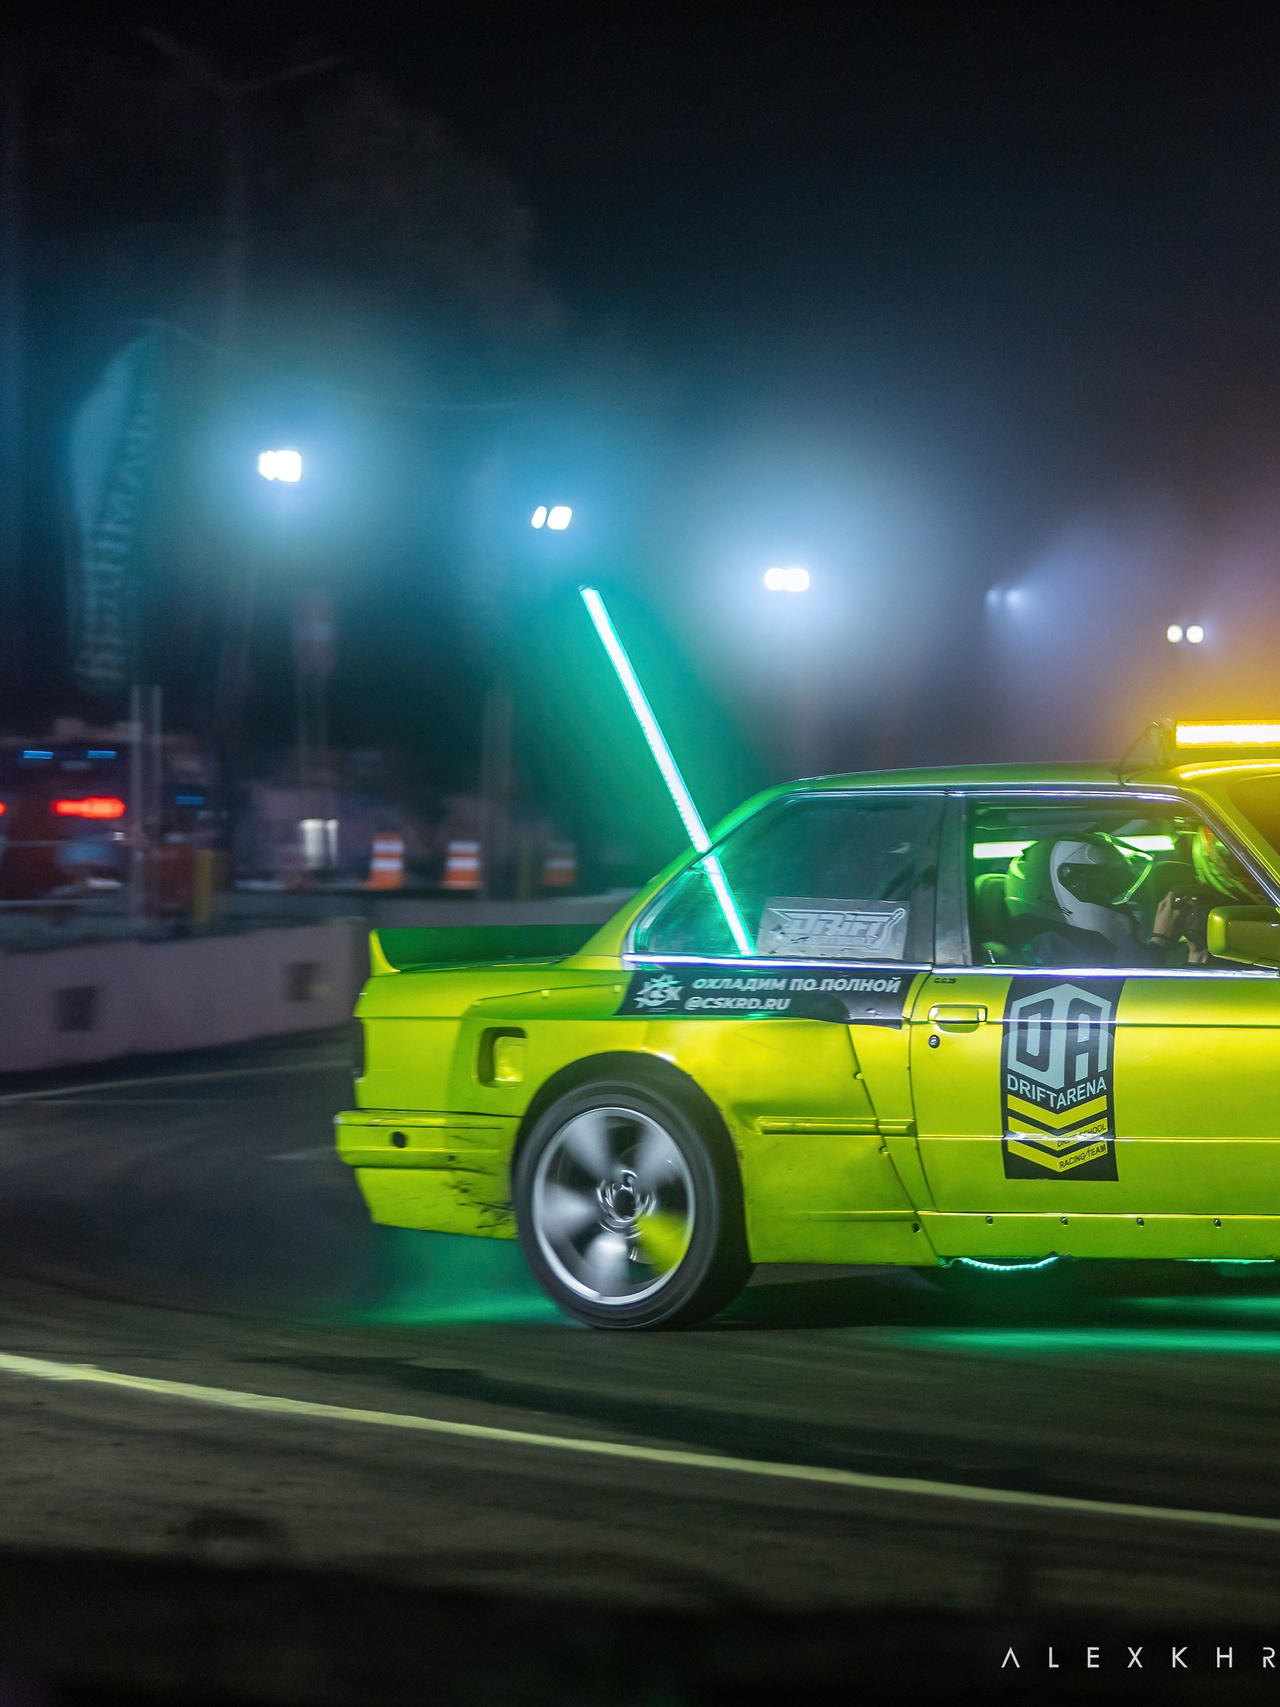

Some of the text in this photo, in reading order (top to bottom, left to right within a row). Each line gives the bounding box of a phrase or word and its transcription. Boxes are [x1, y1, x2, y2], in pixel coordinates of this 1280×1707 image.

[692, 977, 902, 993] ОХЛАДИМ ПО ПОЛНОЙ
[684, 996, 791, 1011] @CSKRD.RU
